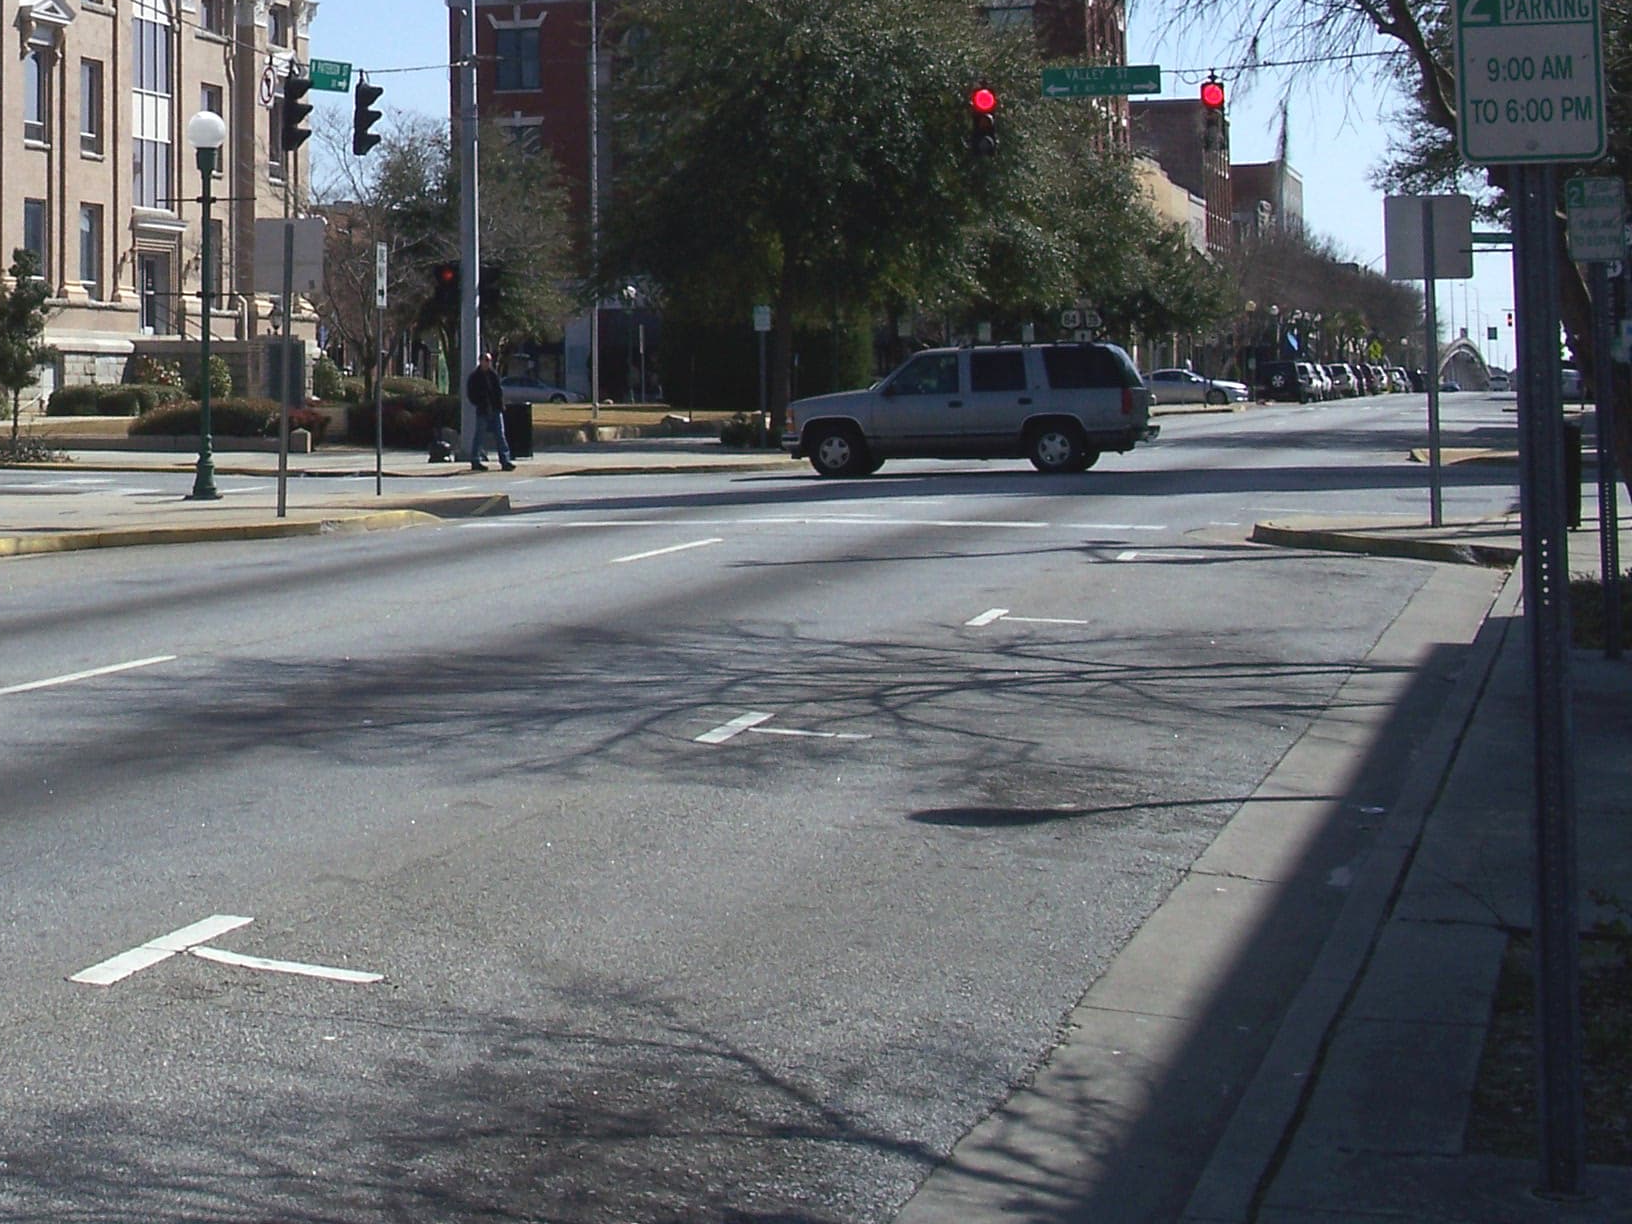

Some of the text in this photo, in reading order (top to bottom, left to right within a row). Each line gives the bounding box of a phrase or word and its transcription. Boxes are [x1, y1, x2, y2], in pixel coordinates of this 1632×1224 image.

[1065, 67, 1128, 81] VALLEY ST
[1487, 55, 1574, 82] 9:00 AM
[1470, 95, 1594, 124] TO 6:00 PM
[1568, 186, 1581, 208] 2
